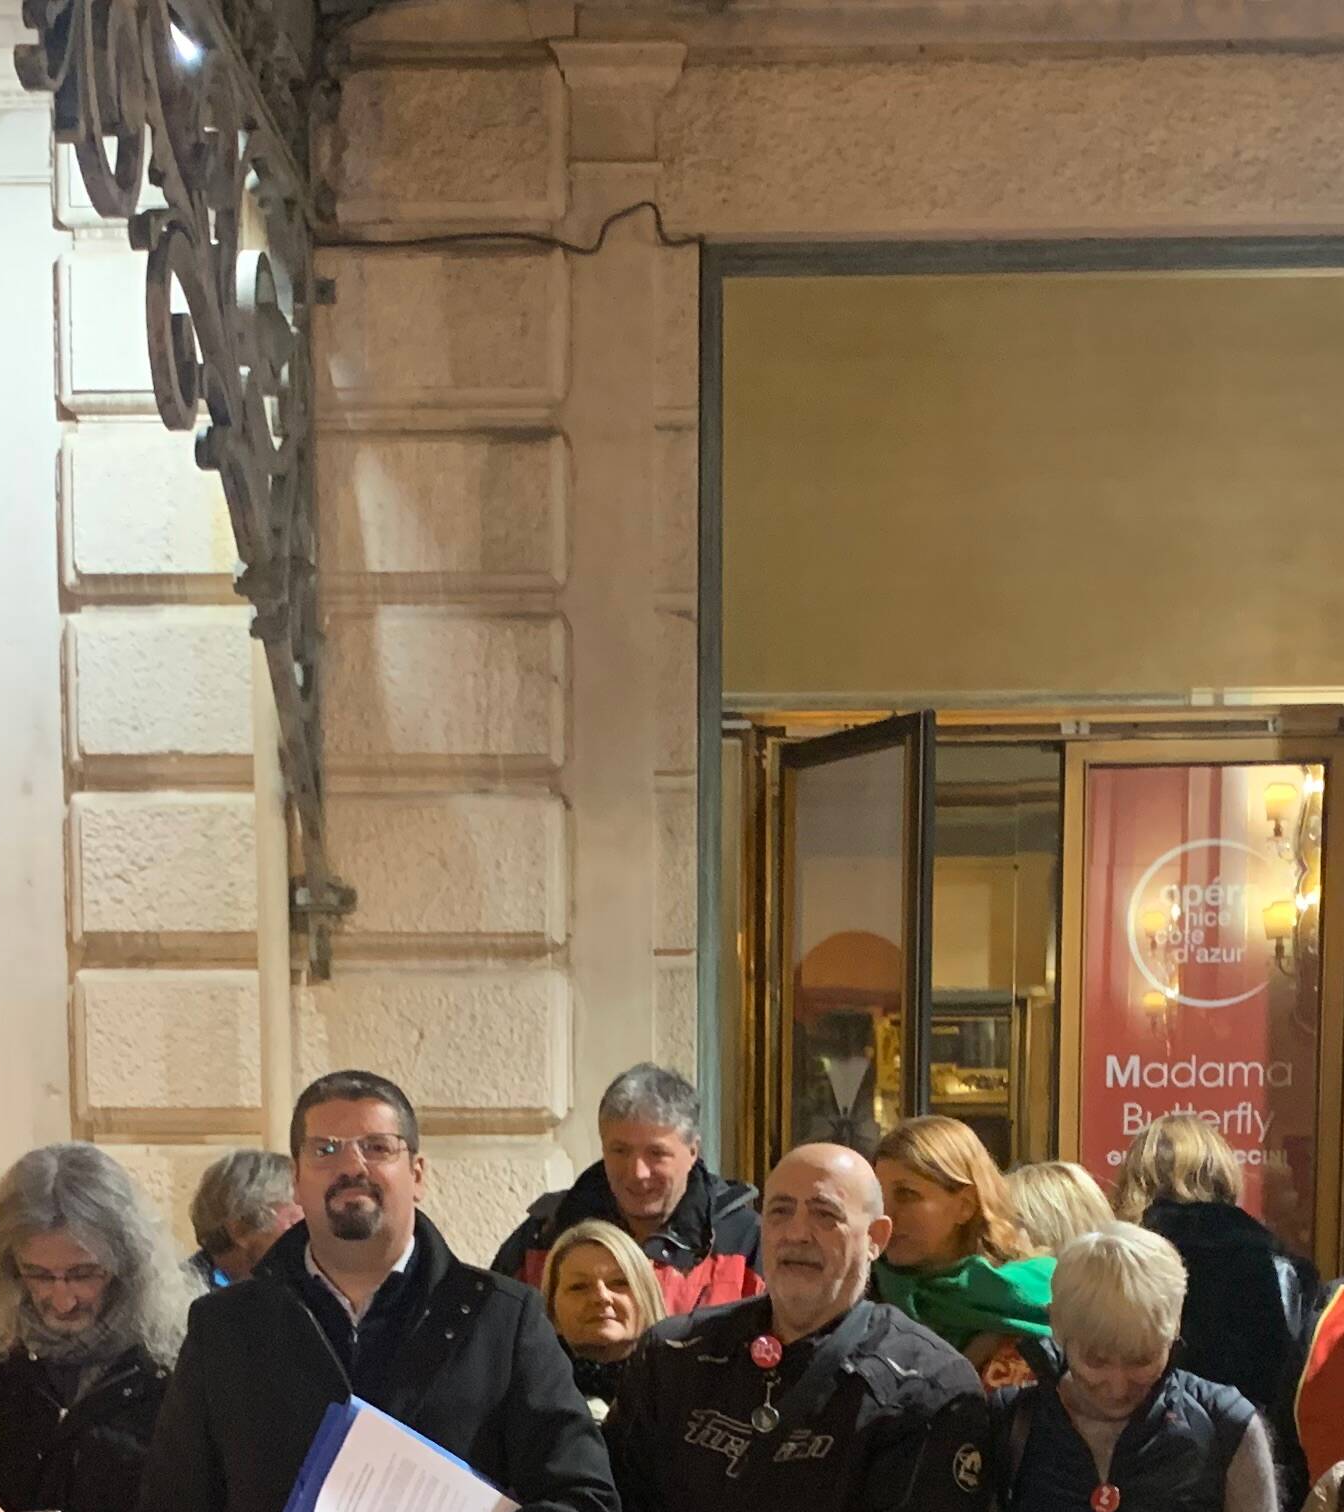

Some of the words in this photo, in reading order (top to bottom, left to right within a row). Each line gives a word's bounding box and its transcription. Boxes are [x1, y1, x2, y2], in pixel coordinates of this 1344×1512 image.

[1160, 872, 1256, 909] opér
[1185, 906, 1232, 928] nice
[1174, 943, 1247, 964] d'azur
[1105, 1054, 1293, 1089] Madama
